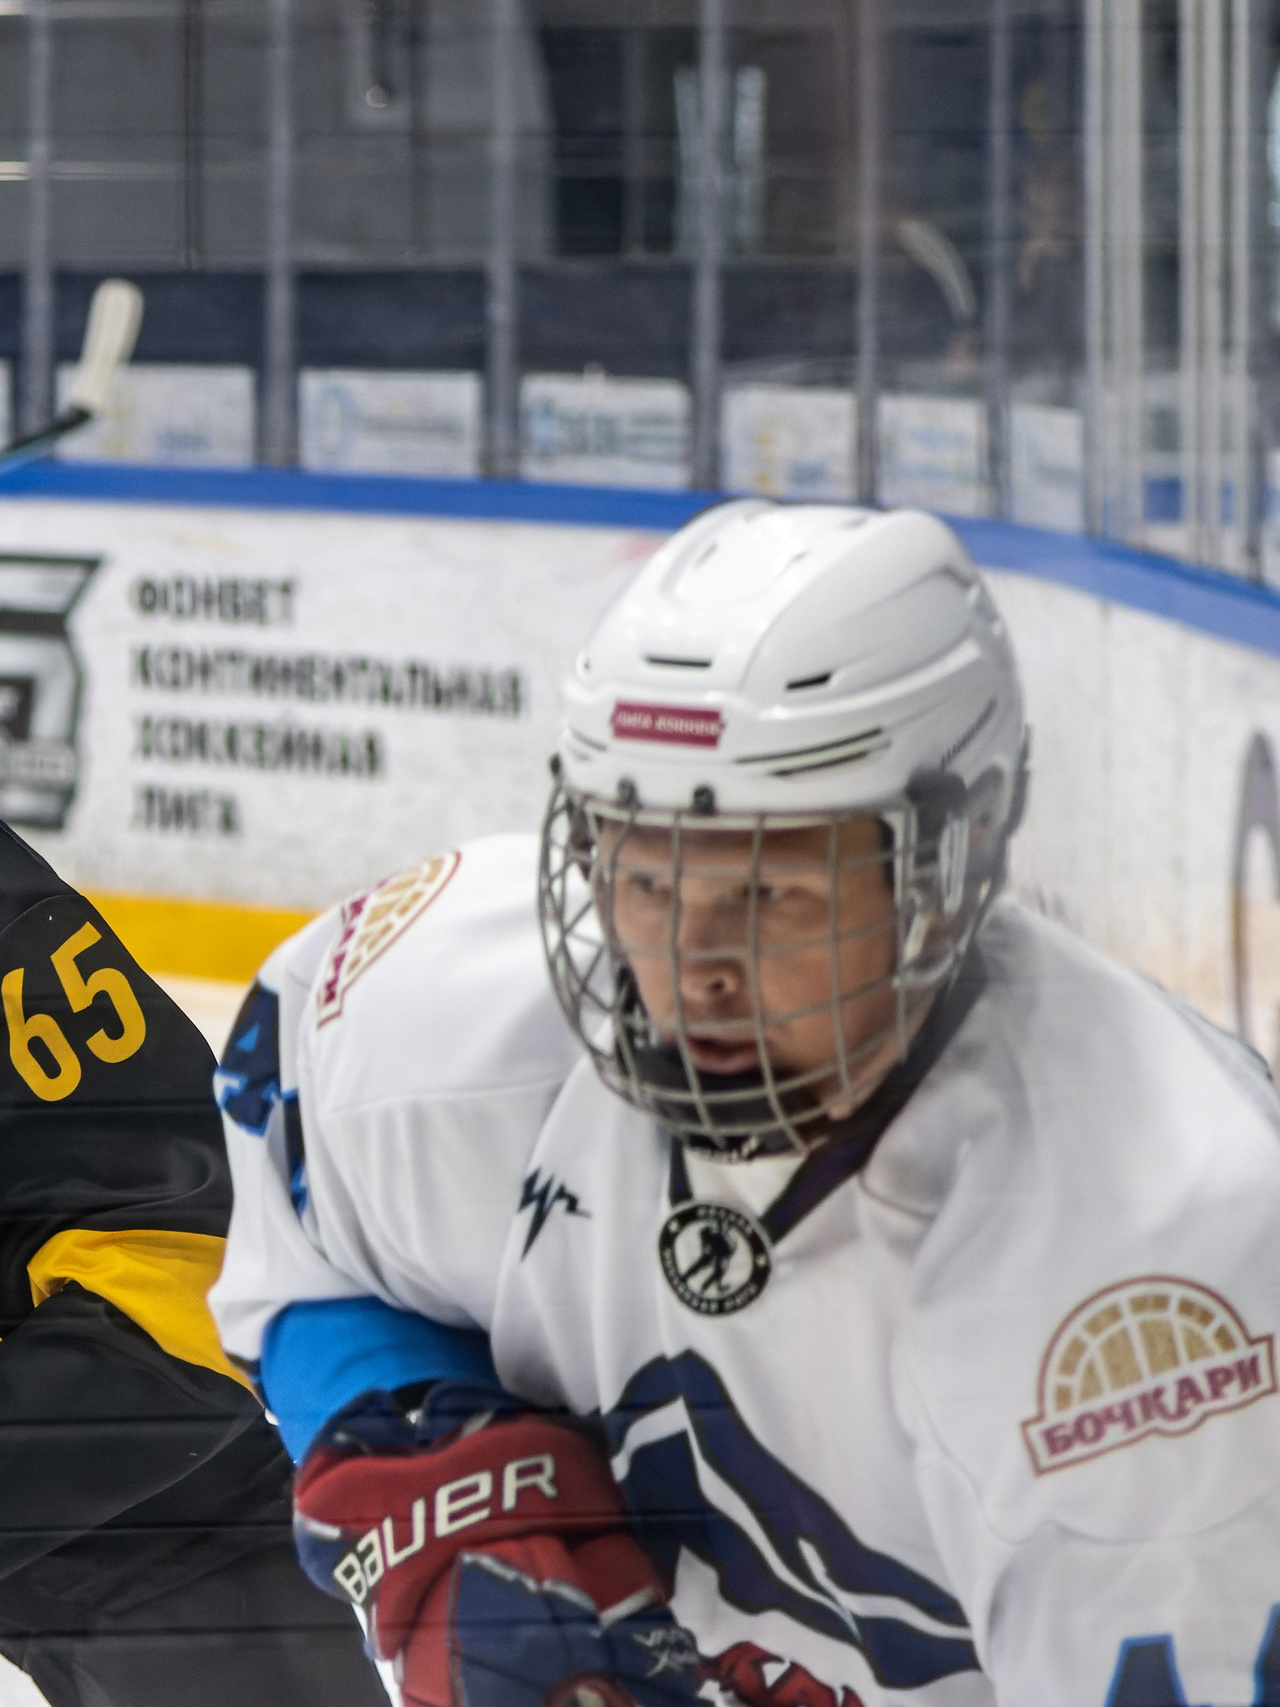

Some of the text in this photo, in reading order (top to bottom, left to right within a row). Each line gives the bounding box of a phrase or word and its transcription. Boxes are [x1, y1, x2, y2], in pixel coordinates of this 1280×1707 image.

[133, 577, 295, 622] ФОНБЕТ
[131, 648, 524, 715] КОНТИНЕНТАЛЬНАЯ
[132, 713, 384, 777] ХОККЕЙНАЯ
[132, 786, 240, 831] ЛИГА
[1, 921, 147, 1102] 65
[1040, 1354, 1262, 1456] БОЧКАРИ
[333, 1453, 558, 1605] BAUER
